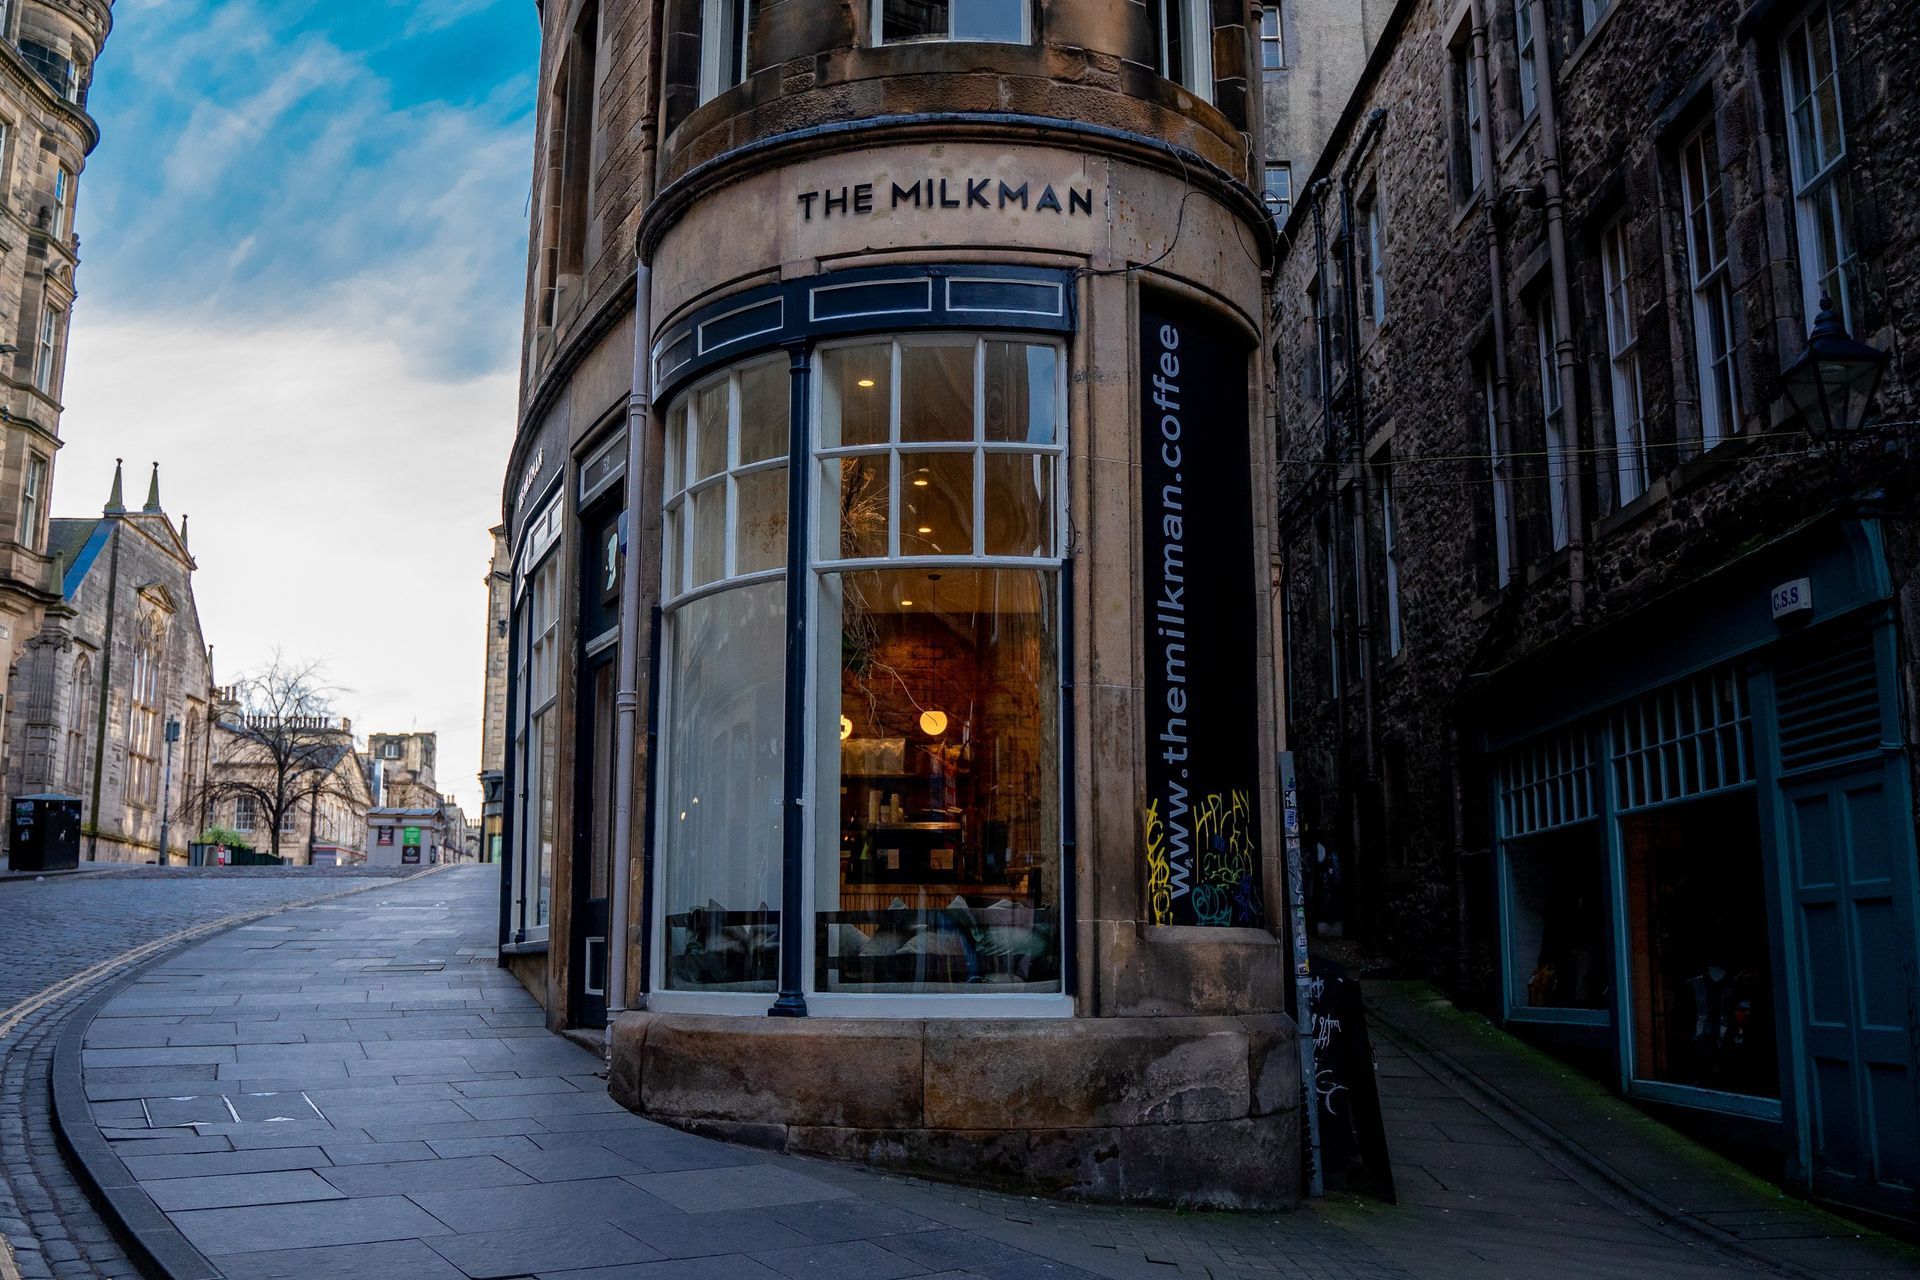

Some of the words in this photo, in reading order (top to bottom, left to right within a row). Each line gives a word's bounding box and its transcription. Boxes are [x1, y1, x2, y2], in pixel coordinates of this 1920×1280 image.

[797, 182, 874, 220] THE
[890, 177, 1093, 216] MILKMAN
[1153, 324, 1191, 900] www.themilkman.coffee
